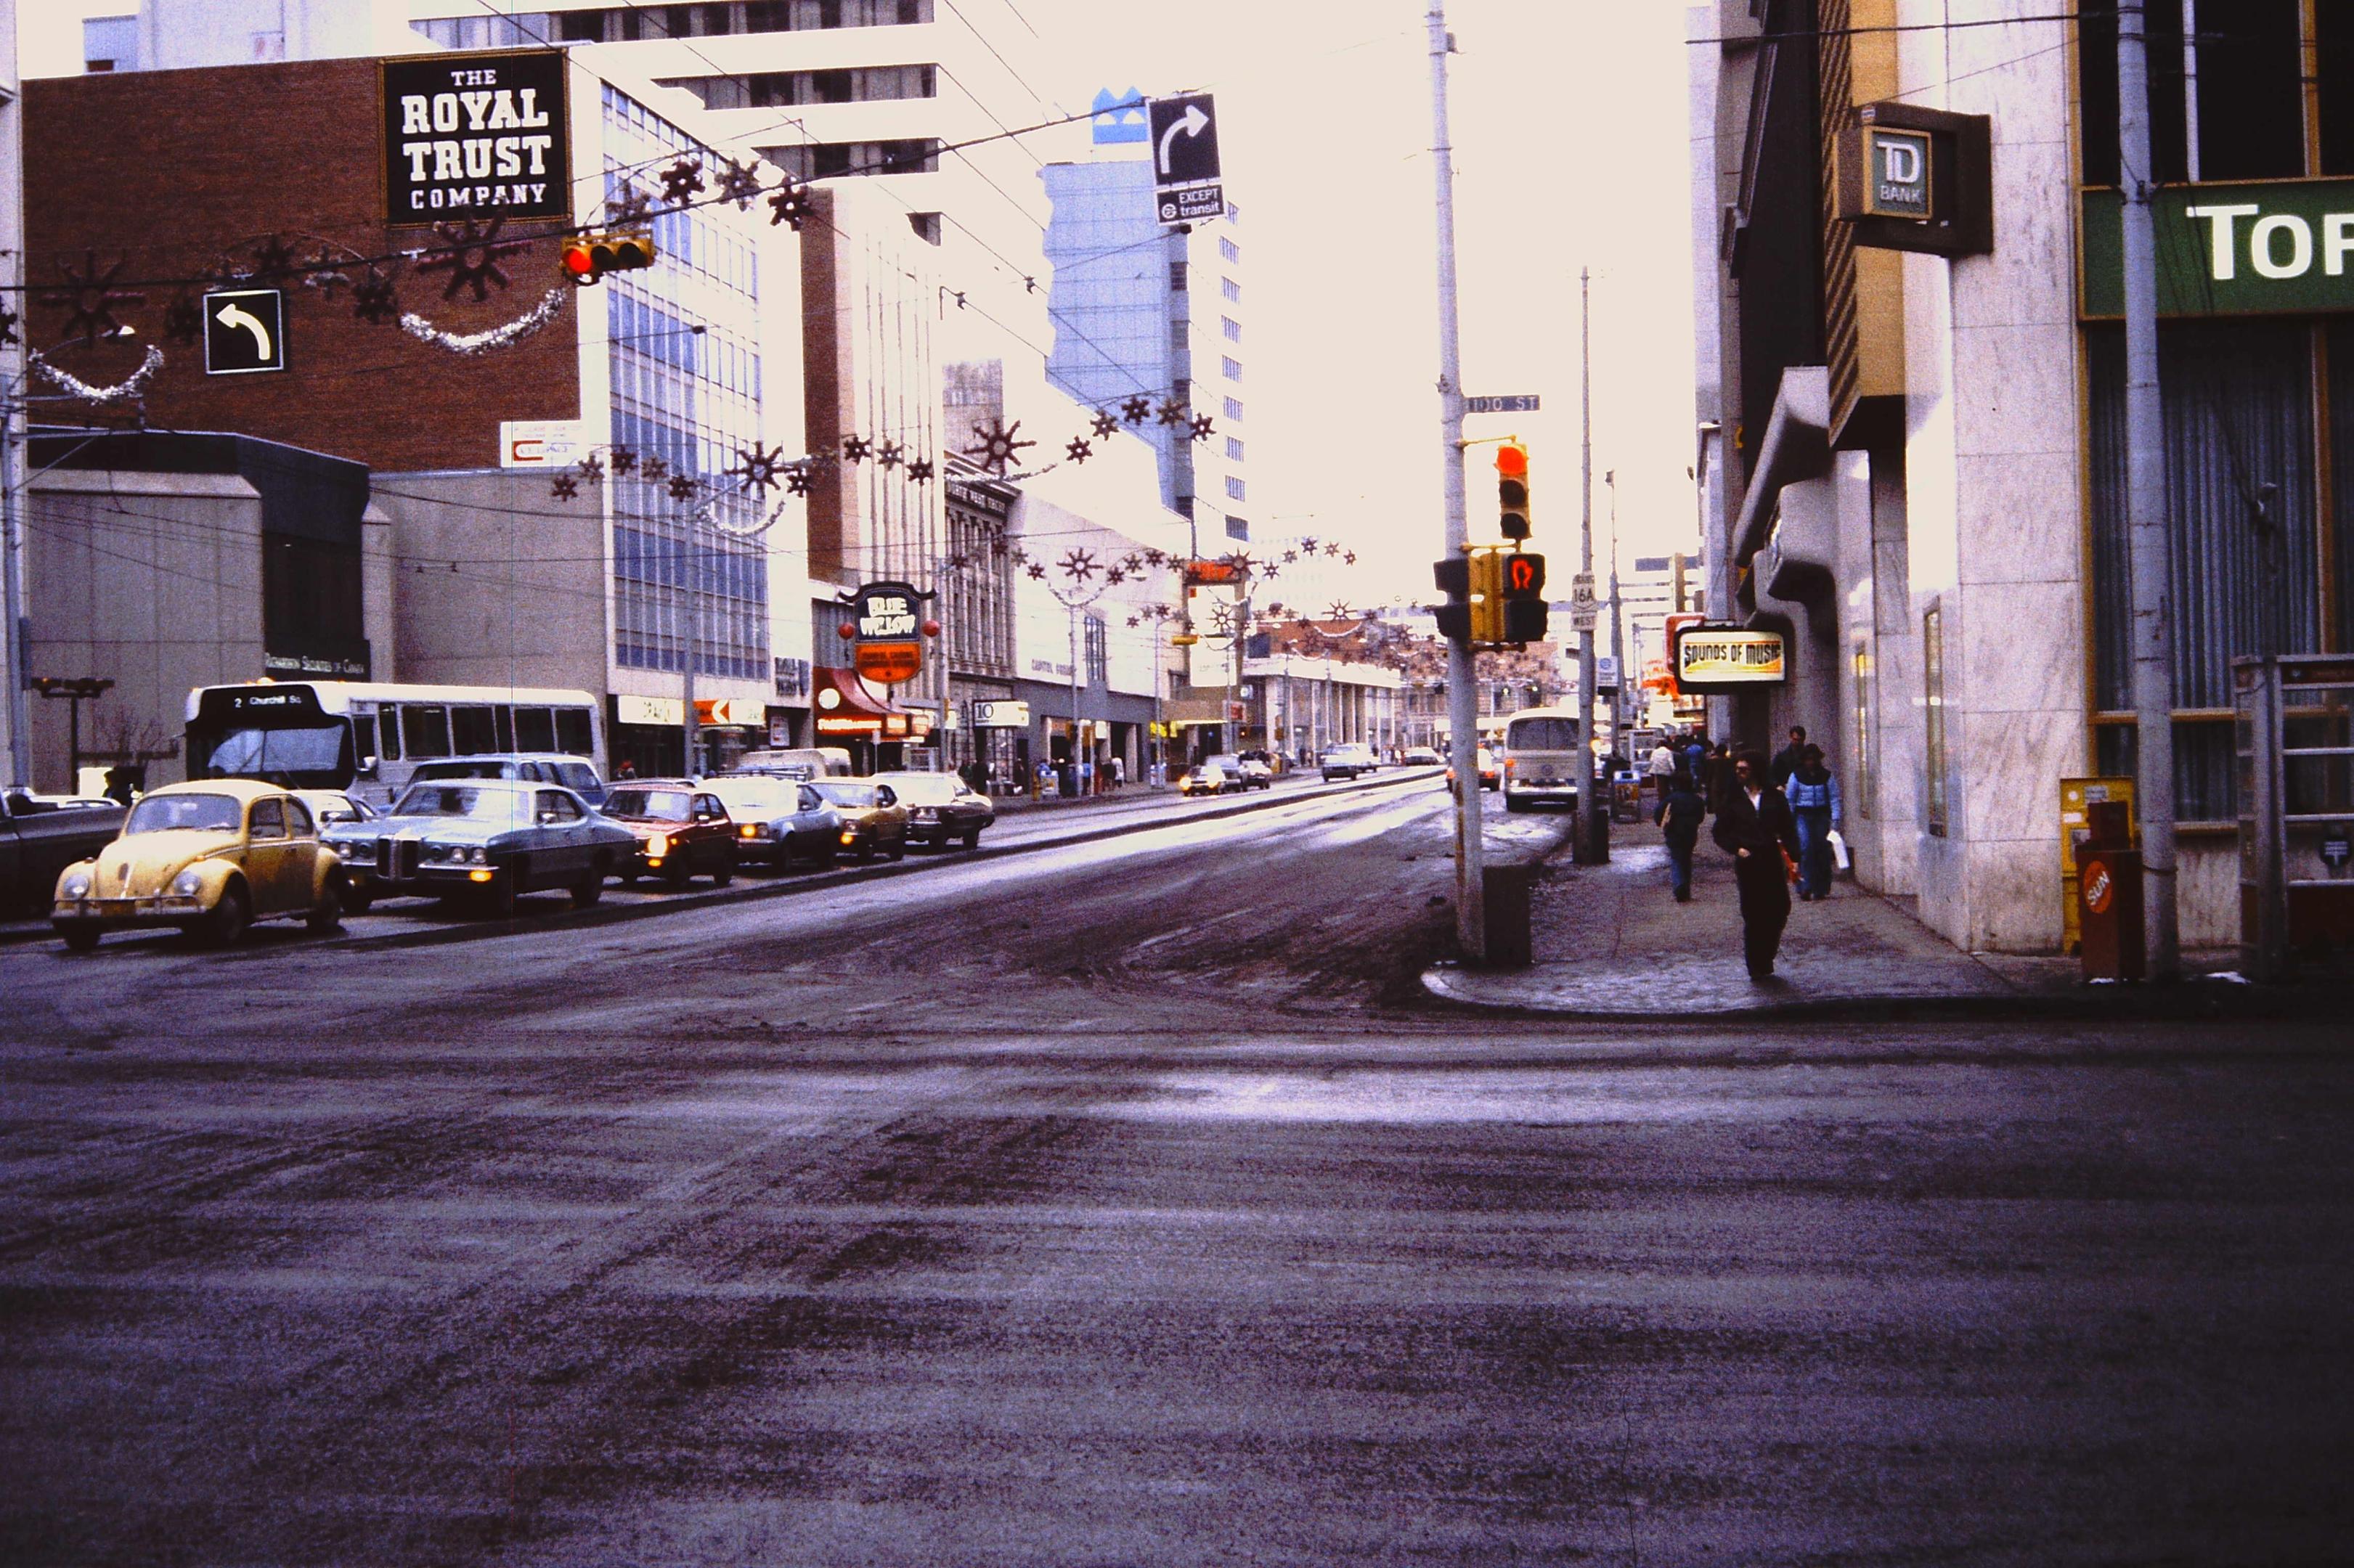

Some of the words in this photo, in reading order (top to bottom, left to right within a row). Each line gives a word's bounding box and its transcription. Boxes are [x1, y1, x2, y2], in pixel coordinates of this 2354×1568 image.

[451, 70, 497, 86] THE
[401, 89, 549, 134] ROYAL
[402, 135, 551, 181] TRUST
[1876, 141, 1921, 183] TD
[411, 184, 546, 209] COMPANY
[1179, 189, 1218, 203] EXCEPT
[1880, 186, 1921, 203] BANK
[1181, 201, 1220, 216] transit
[1515, 396, 1536, 410] ST
[1574, 588, 1594, 603] 16A
[1573, 617, 1595, 626] WEST
[1731, 645, 1742, 662] OF
[234, 698, 242, 708] 2
[977, 703, 994, 719] 10
[2087, 870, 2111, 906] SUN
